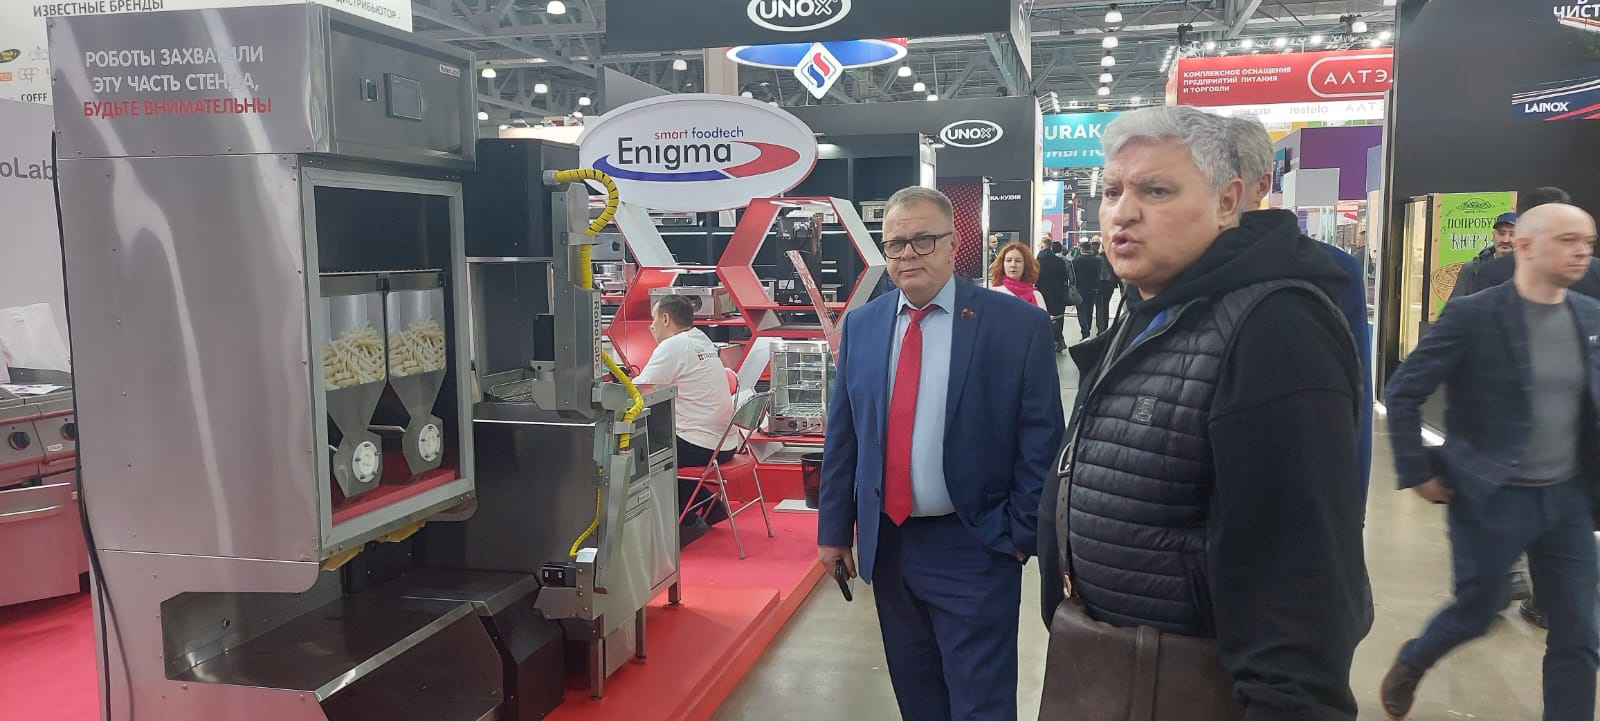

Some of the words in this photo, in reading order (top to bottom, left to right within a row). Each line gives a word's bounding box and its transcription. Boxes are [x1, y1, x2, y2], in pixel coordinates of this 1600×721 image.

[33, 1, 106, 17] ИЗВЕСТНЫЕ
[110, 0, 164, 12] БРЕНДЫ
[760, 0, 833, 19] UNOX
[85, 49, 155, 67] РОБОТЫ
[1183, 69, 1240, 78] КОМПЛЕКСНОЕ
[1241, 67, 1292, 75] ОСНАЩЕНИЕ
[1183, 76, 1238, 85] ПРЕДПРИЯТИЙ
[1241, 75, 1278, 83] ПИТАНИЯ
[1324, 68, 1394, 85] АЛТЭ
[93, 76, 122, 92] ЭТУ
[128, 74, 181, 92] ЧАСТЬ
[185, 72, 259, 92] СТЕНА,
[83, 101, 138, 119] БУДЬТЕ
[144, 98, 272, 116] ВНИМАТЕЛЬНЫ
[1525, 102, 1568, 113] LAINOX
[654, 129, 688, 140] smart
[692, 126, 744, 139] foodtech
[947, 127, 992, 140] UNOX
[618, 137, 732, 170] Enigma
